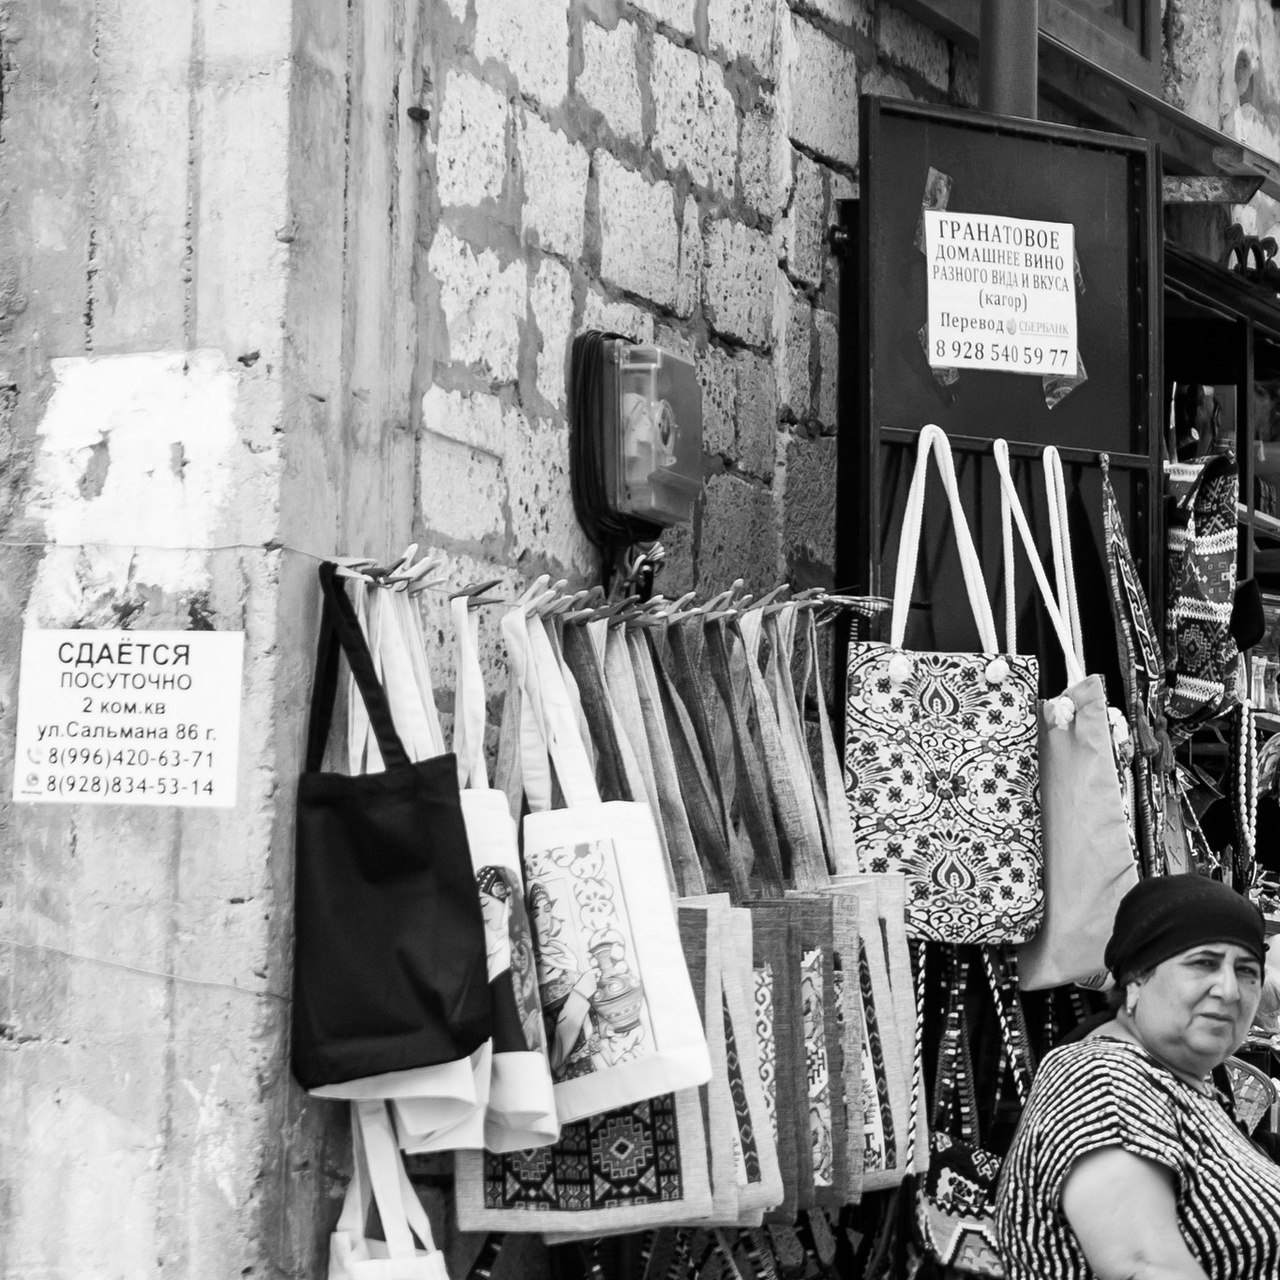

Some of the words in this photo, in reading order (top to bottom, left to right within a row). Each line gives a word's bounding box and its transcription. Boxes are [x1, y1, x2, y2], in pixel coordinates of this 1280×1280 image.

[938, 219, 1060, 250] ГРАНАТОВОЕ
[935, 244, 1020, 267] ДОМАШНЕЕ
[1024, 252, 1064, 271] ВИНО
[933, 264, 988, 284] РАЗНОГО
[991, 269, 1018, 289] ВИДА
[1021, 273, 1030, 288] И
[1033, 274, 1070, 292] ВКУСА
[978, 288, 1028, 313] (кагор)
[940, 311, 1005, 334] Перевод
[1019, 320, 1069, 335] СБЕРБАНК
[936, 339, 946, 358] 8
[951, 340, 985, 360] 928
[990, 343, 1019, 363] 540
[1023, 346, 1043, 365] 59
[1049, 349, 1069, 367] 77
[58, 637, 190, 667] СДАЁТСЯ
[61, 672, 192, 691] ПОСУТОЧНО
[82, 697, 93, 713] 2
[100, 700, 166, 714] ком.кв
[37, 721, 168, 741] ул.Сальмана
[175, 723, 199, 740] 86
[206, 728, 217, 741] г.
[48, 747, 214, 769] 8(996)420-63-71
[46, 775, 214, 797] 8(928)834-53-14
